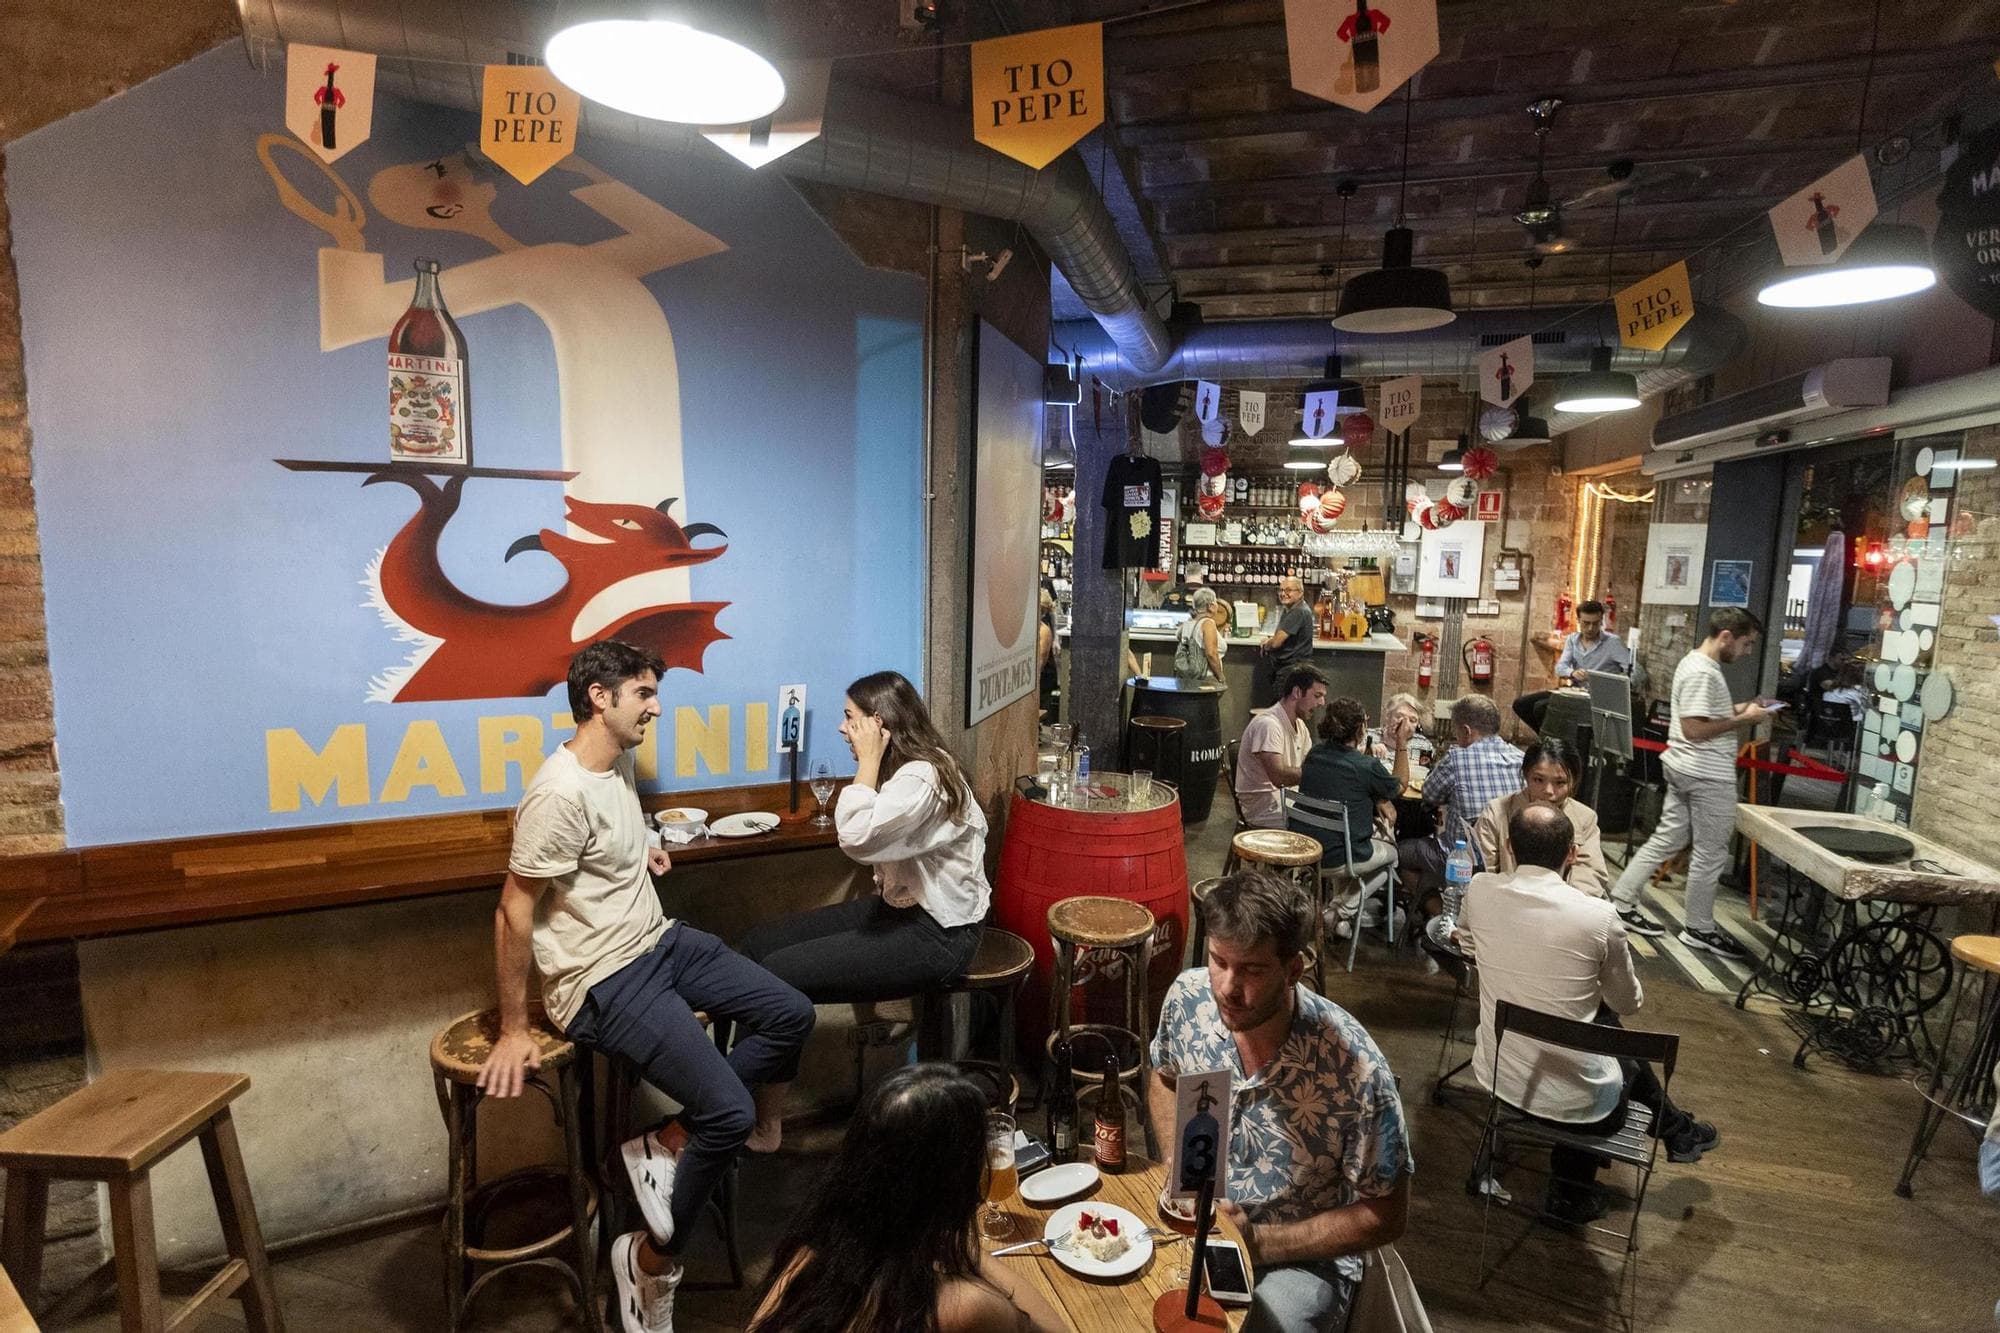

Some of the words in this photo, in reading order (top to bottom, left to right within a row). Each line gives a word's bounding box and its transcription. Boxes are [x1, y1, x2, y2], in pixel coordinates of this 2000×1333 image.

[1003, 59, 1073, 94] TIO
[506, 90, 557, 115] TIO
[991, 89, 1088, 127] PEPE
[493, 119, 563, 143] PEPE
[1632, 288, 1671, 316] TIO
[1628, 301, 1683, 337] PEPE
[1244, 402, 1260, 413] TIO
[1390, 389, 1411, 405] TIO
[1241, 413, 1261, 424] PEPE
[1384, 403, 1415, 419] PEPE
[979, 667, 1009, 710] PUNT
[783, 716, 799, 740] 15
[265, 702, 769, 813] MARINI
[1184, 1134, 1214, 1175] 3
